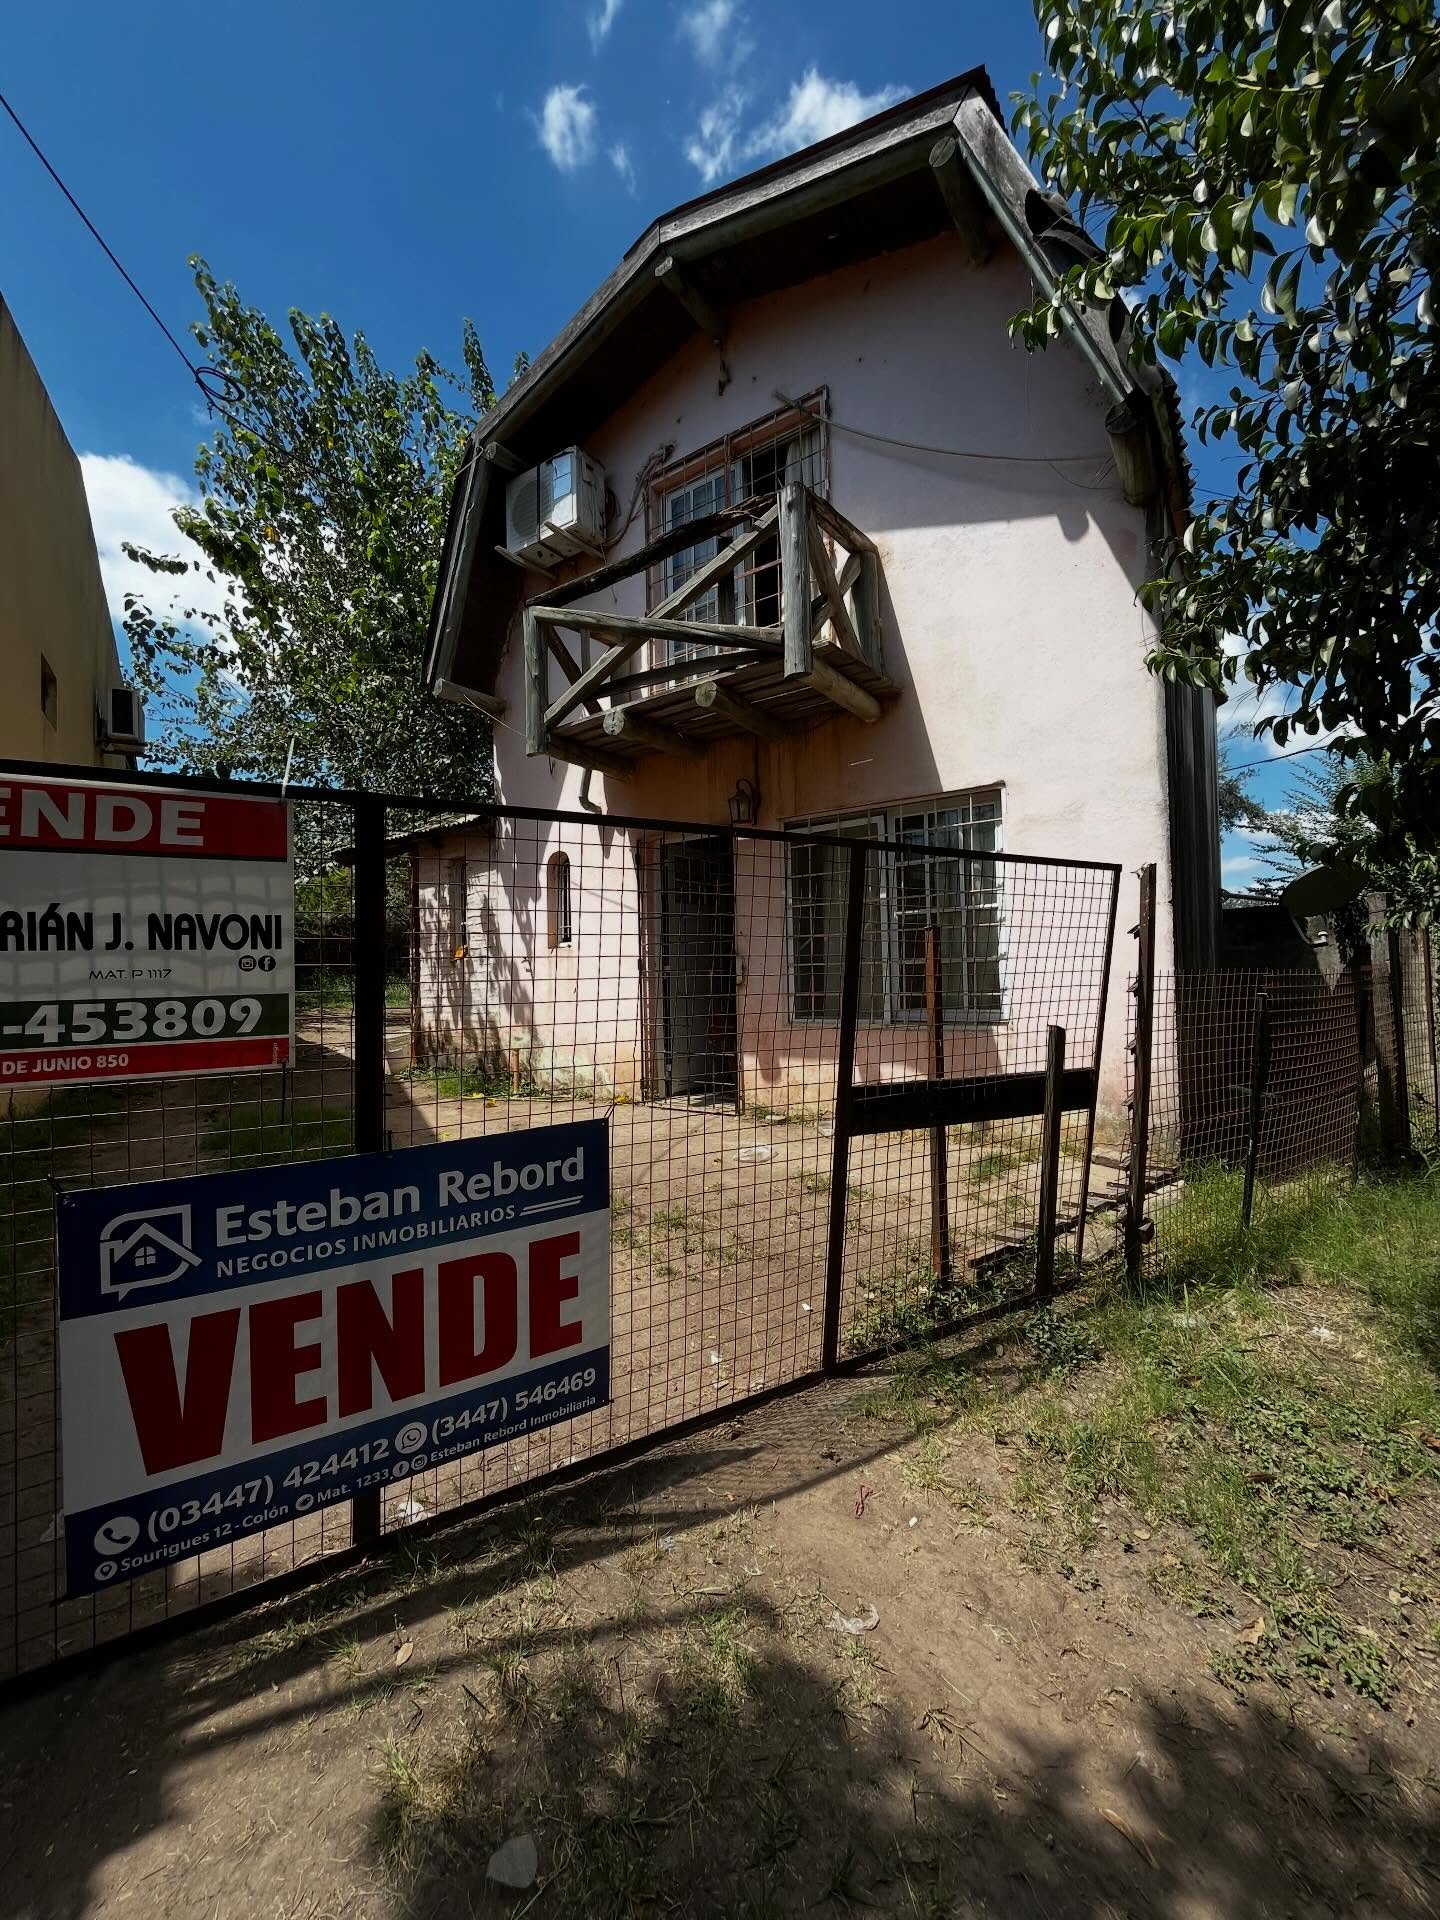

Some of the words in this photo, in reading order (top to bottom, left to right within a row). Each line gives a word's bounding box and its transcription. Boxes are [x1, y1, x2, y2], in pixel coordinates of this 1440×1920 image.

[0, 787, 206, 847] NDE
[105, 913, 135, 951] J.
[148, 914, 282, 951] NAVONI
[89, 969, 128, 980] MAT.
[132, 969, 144, 980] P
[147, 968, 172, 979] 1117
[2, 1060, 29, 1075] DE
[31, 1056, 92, 1073] JUNIO
[96, 1053, 129, 1068] 850
[216, 1184, 420, 1247] Esteban
[439, 1146, 584, 1207] Rebord
[216, 1238, 346, 1278] NEGOCIOS
[353, 1204, 515, 1252] INMOBILIARIOS
[113, 1231, 583, 1476] VENDE
[120, 1532, 210, 1572] Sourigues
[317, 1483, 351, 1503] Mat.
[430, 1440, 480, 1462] Esteban
[484, 1420, 527, 1443] Rebord
[530, 1395, 596, 1428] Inmobiliaria
[147, 1474, 274, 1543] (03447)
[282, 1438, 390, 1489] 424412
[432, 1397, 509, 1445] (3447)
[515, 1367, 596, 1411] 546469
